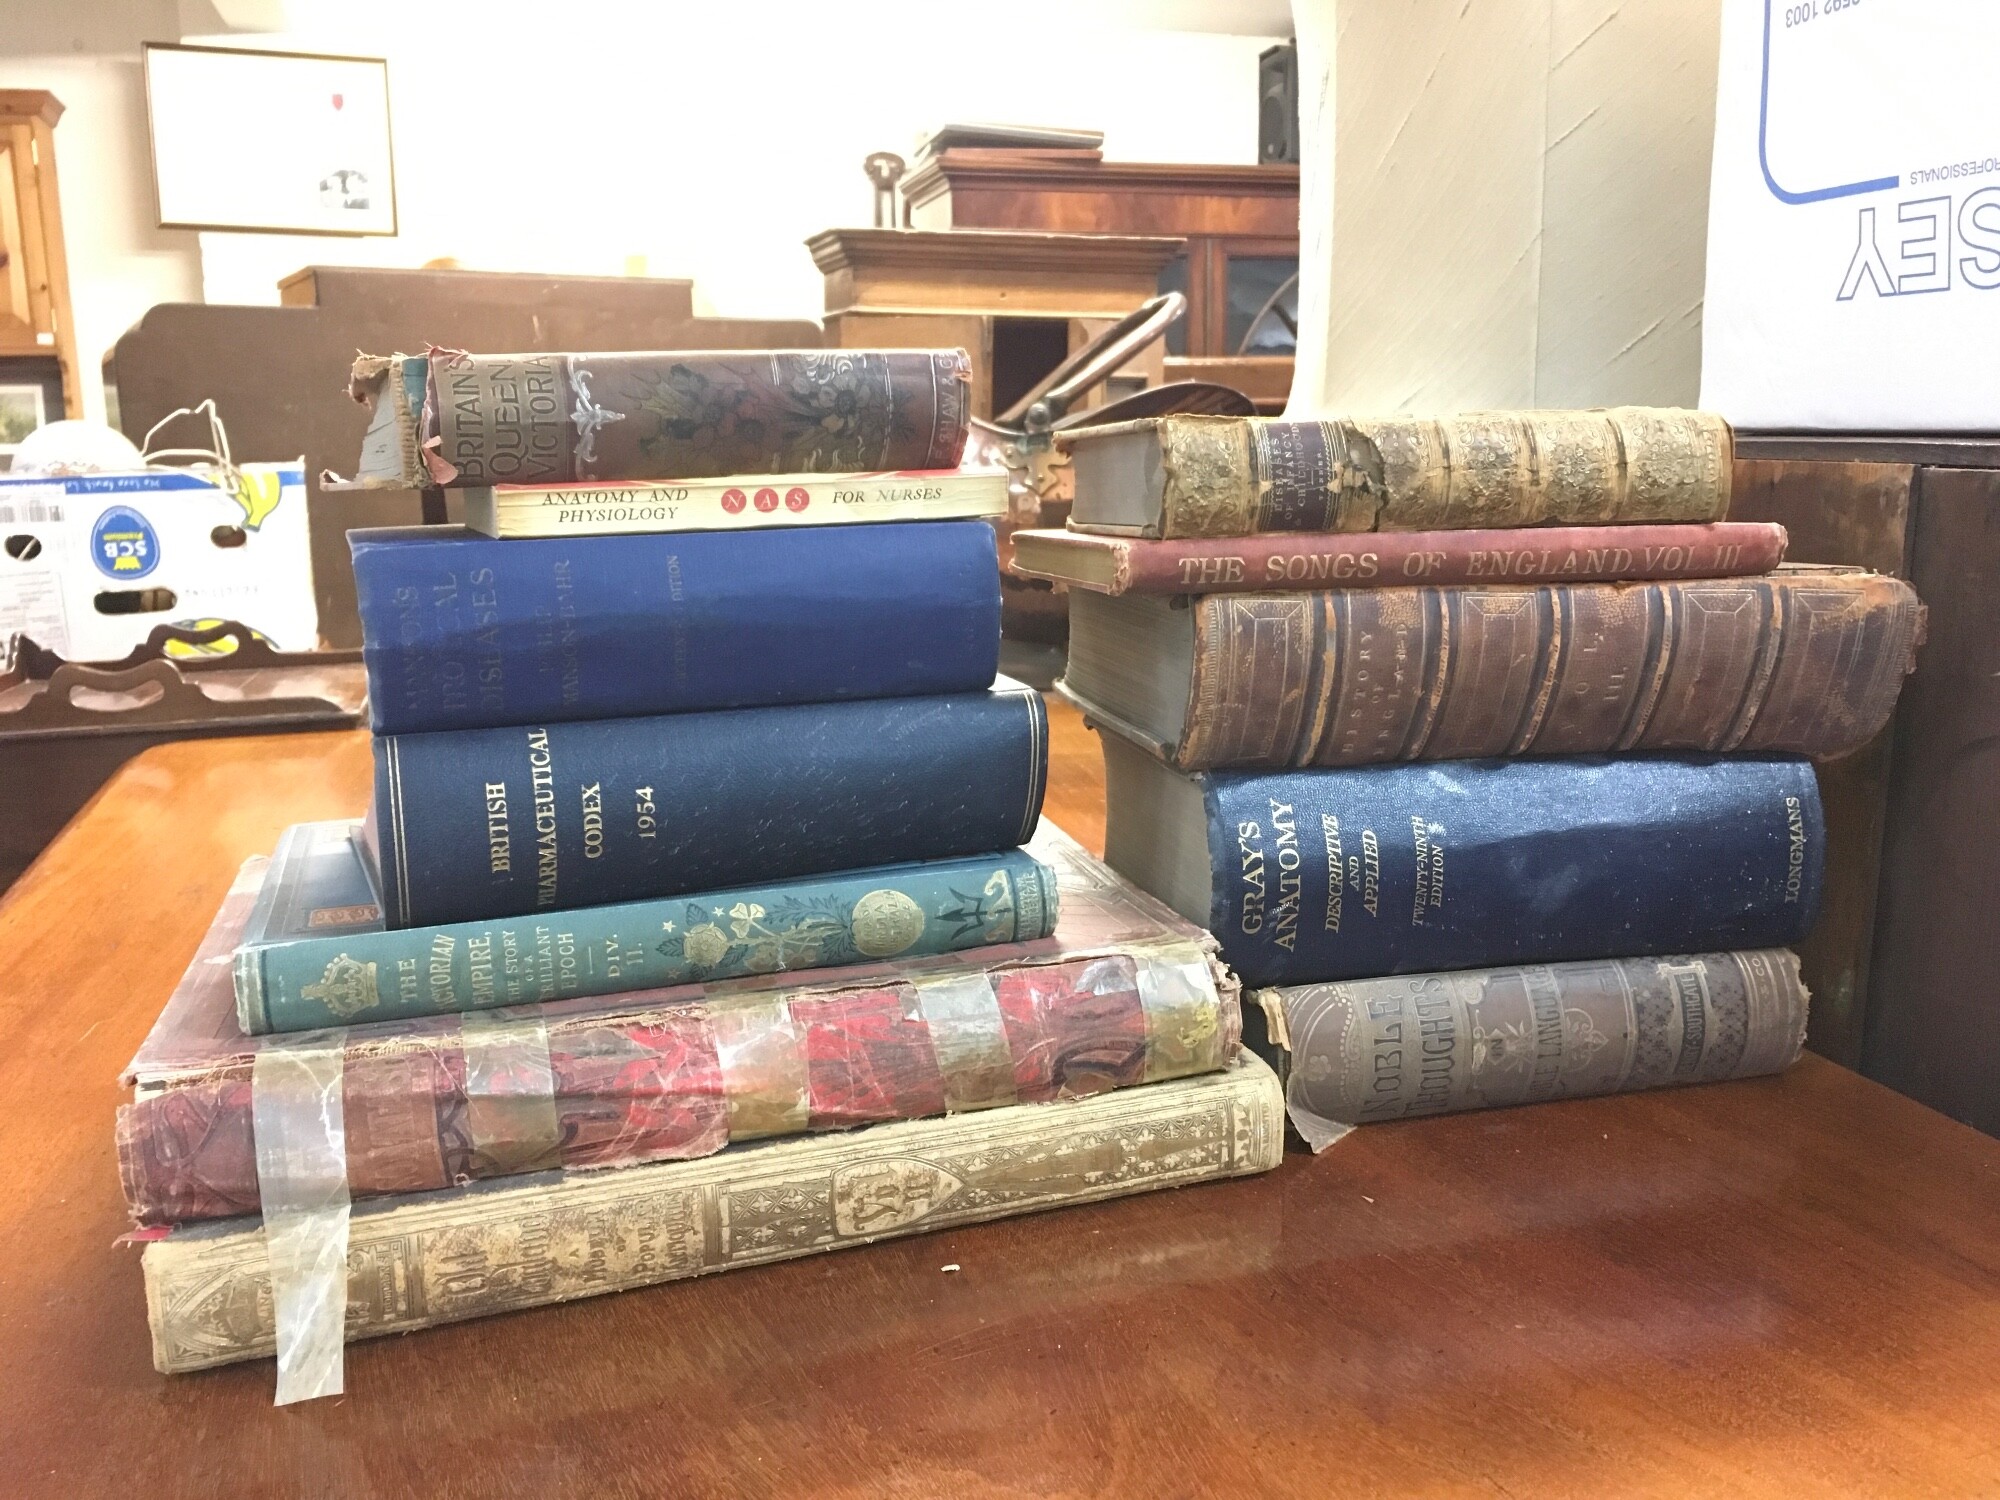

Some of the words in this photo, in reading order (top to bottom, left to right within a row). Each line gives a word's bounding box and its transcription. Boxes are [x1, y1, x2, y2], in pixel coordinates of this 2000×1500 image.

[1785, 0, 1818, 28] 1003
[444, 356, 485, 480] BRITAIN'S
[524, 355, 559, 480] VICTORIA
[1270, 437, 1283, 512] DISEASES
[1281, 431, 1295, 491] INFANCY
[542, 488, 636, 506] ANATOMY
[648, 487, 689, 502] AND
[558, 506, 679, 524] PHYSIOLOGY
[832, 490, 865, 504] FOR
[876, 487, 942, 502] NURSES
[1284, 506, 1294, 520] OF
[104, 540, 148, 558] SCB
[1178, 556, 1246, 585] THE
[1265, 552, 1378, 582] SONGS
[1402, 551, 1447, 578] OF
[667, 554, 684, 610] DITION
[1341, 630, 1372, 753] HISTORY
[485, 782, 511, 874] BRITISH
[581, 781, 604, 859] CODEX
[635, 785, 657, 839] 1954
[1238, 821, 1266, 935] GRAY'S
[1269, 797, 1302, 953] ANATOMY
[1321, 813, 1344, 934] DESCRIPTIVE
[1349, 855, 1361, 892] AND
[1362, 829, 1380, 918] APPLIED
[1411, 814, 1429, 927] TWENTY-NINTH
[1430, 843, 1444, 908] EDITION
[1784, 796, 1804, 904] LONGMANS
[396, 958, 418, 1003] THE
[502, 929, 518, 974] STORY
[525, 965, 535, 982] OF
[557, 932, 578, 991] EPOCH
[507, 976, 521, 1002] THE
[1680, 973, 1703, 1040] SOUTHGATE
[1360, 993, 1404, 1116] NOBLE
[1403, 977, 1457, 1115] THOUGHTS
[1491, 1038, 1504, 1057] IN
